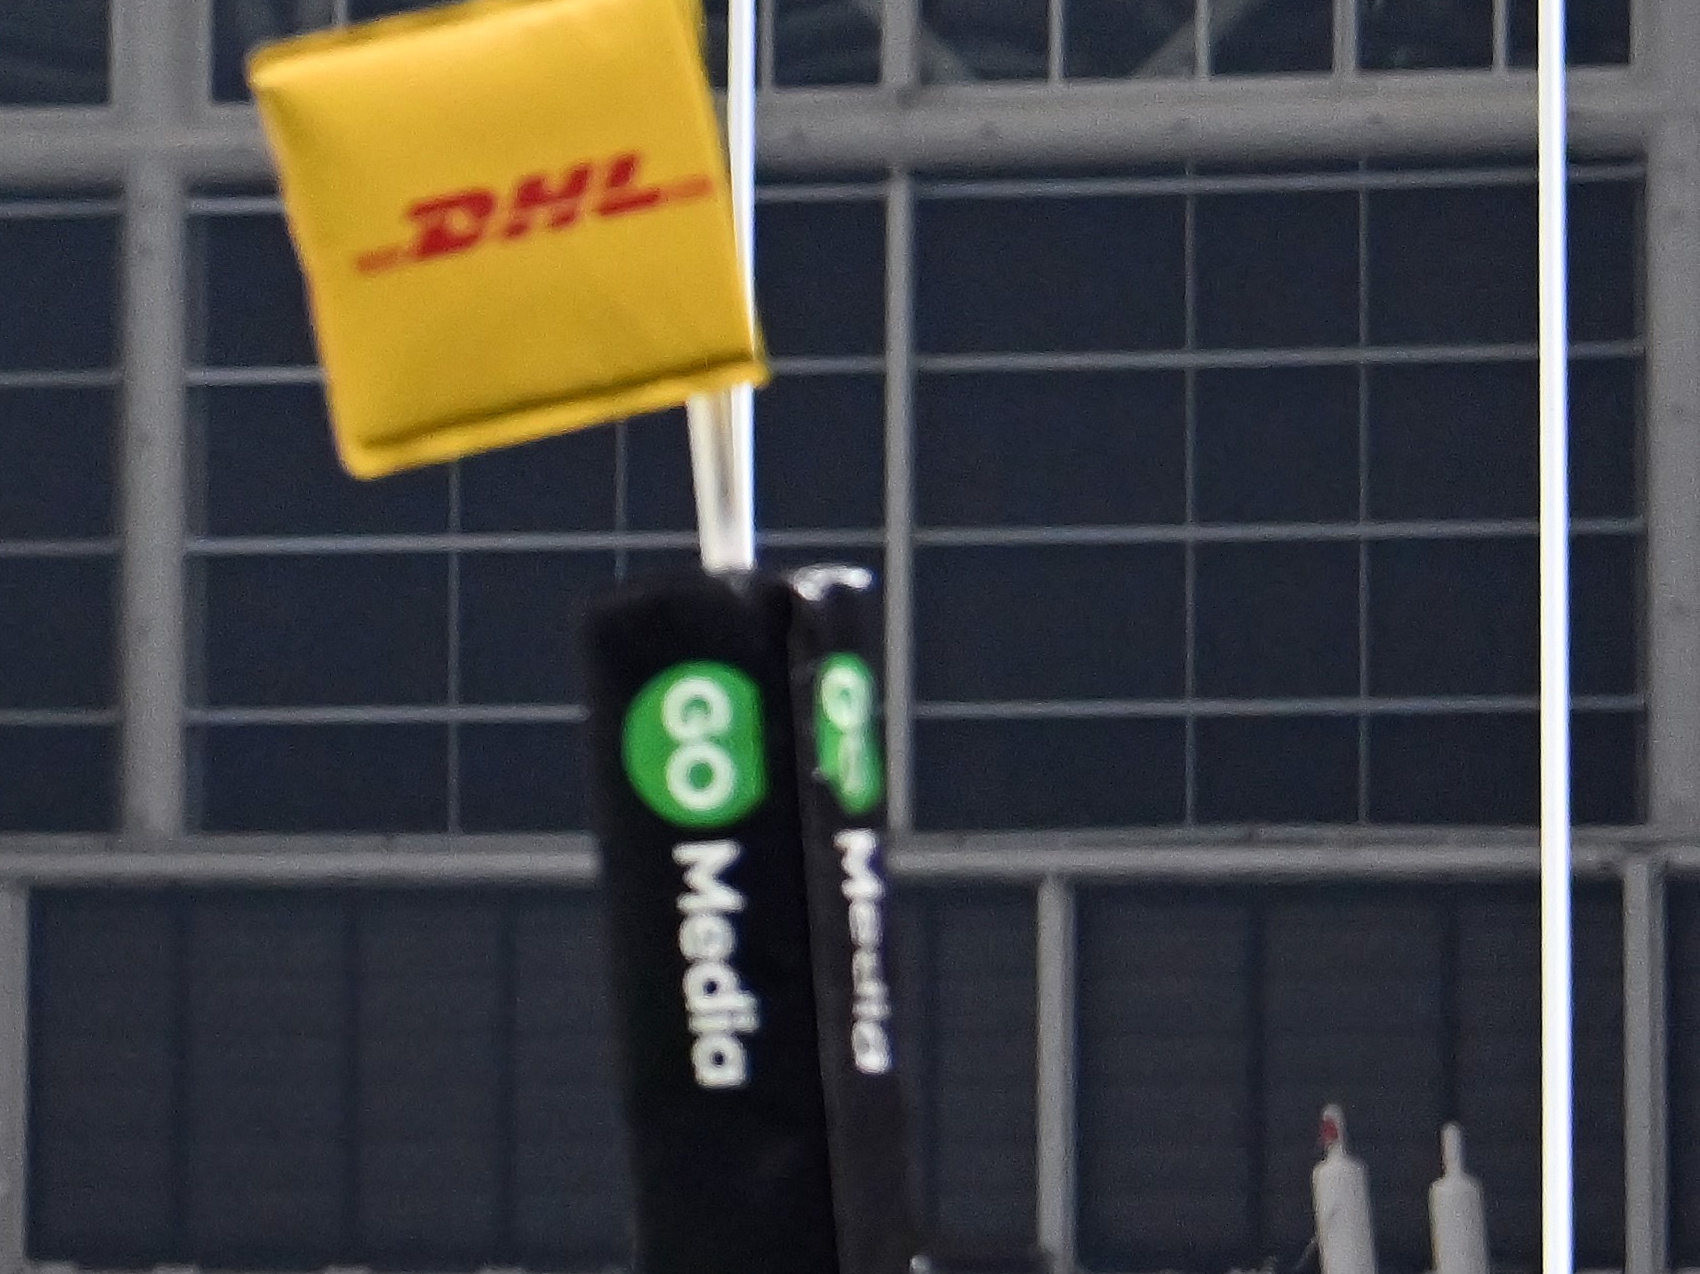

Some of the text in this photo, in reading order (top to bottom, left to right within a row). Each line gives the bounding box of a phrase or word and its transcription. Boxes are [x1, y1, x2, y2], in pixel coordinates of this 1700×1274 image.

[407, 151, 663, 261] DHL
[662, 676, 761, 1089] GO Media
[833, 828, 892, 1074] Media
